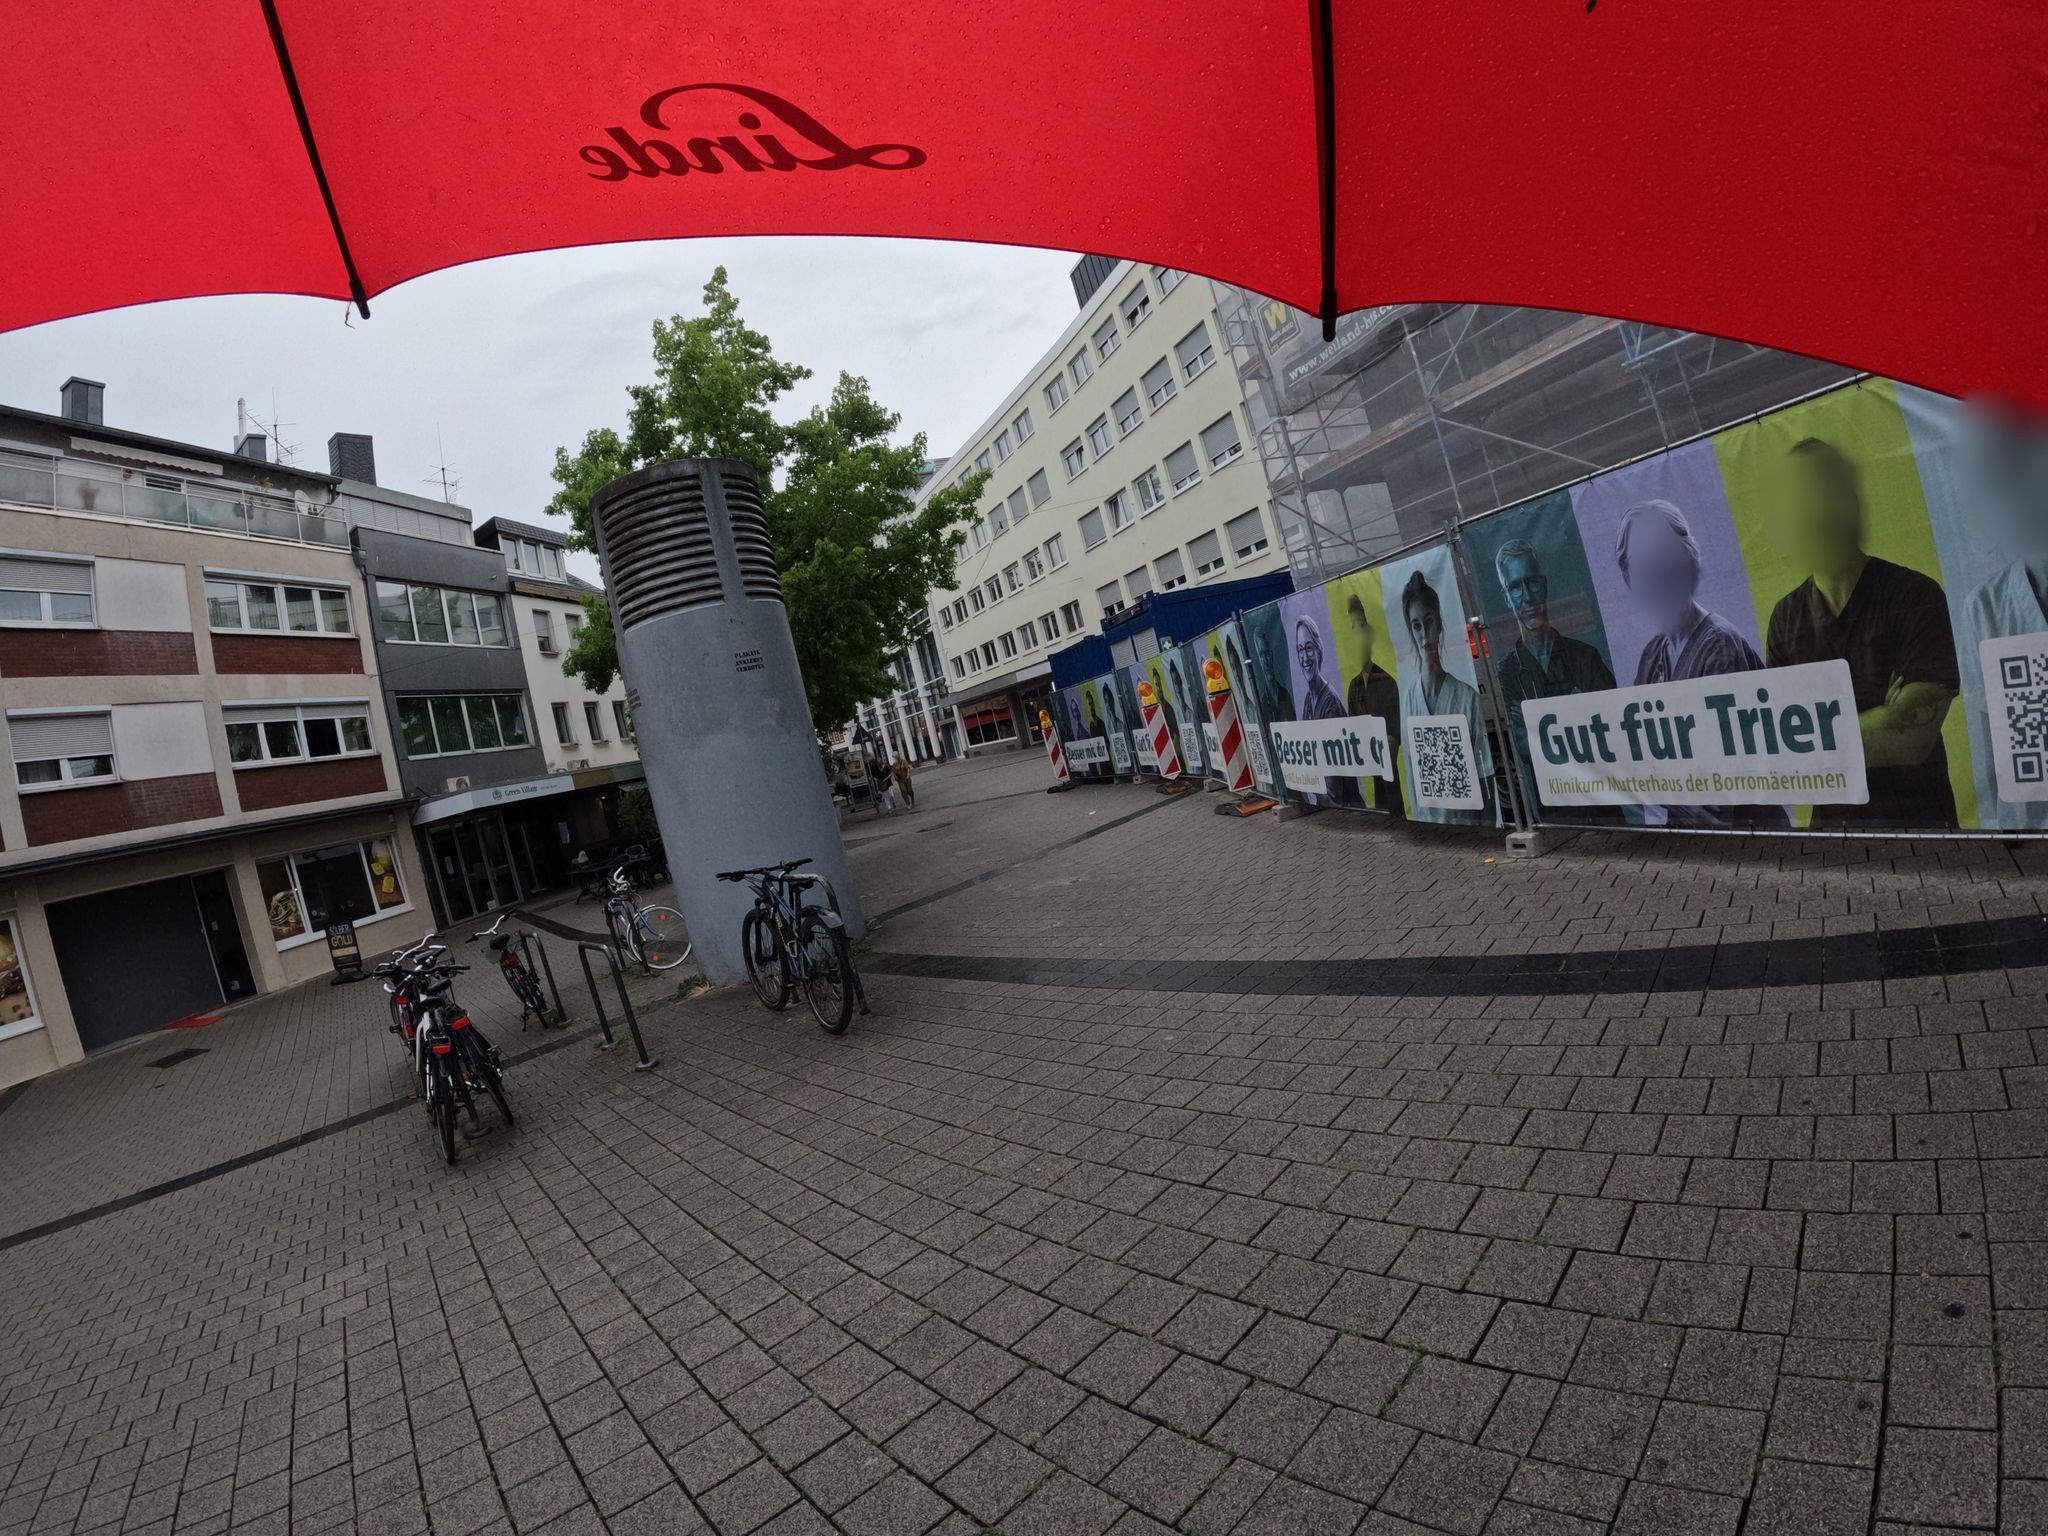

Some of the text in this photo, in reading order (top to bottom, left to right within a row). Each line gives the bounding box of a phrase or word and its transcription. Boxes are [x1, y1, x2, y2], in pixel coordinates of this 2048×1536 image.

[735, 650, 760, 659] PLAKATE
[1538, 688, 1841, 766] Gut für Trier
[1274, 732, 1318, 766] Besser
[1322, 728, 1364, 766] mit
[1549, 771, 1847, 795] Klinikum Mutterhaus der Borromäerinnen
[504, 789, 520, 797] Green
[331, 934, 353, 947] GOLD
